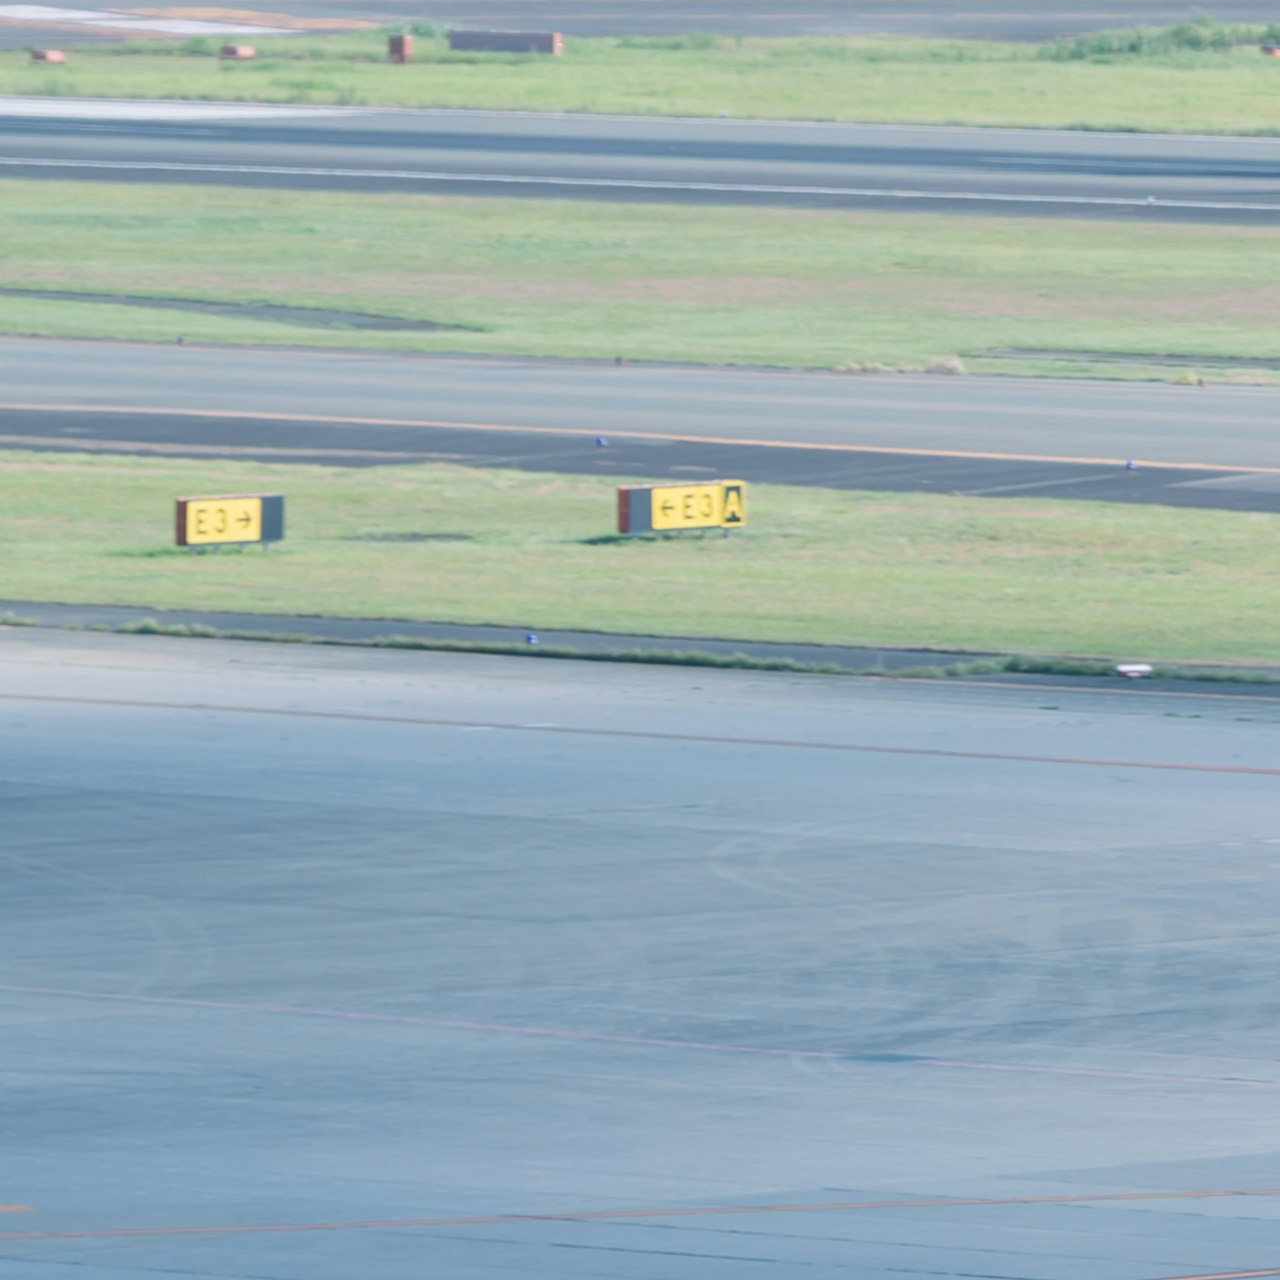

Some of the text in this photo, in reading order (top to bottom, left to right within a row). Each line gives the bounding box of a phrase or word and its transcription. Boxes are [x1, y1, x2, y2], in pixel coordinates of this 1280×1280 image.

[682, 485, 744, 521] E3 A
[195, 507, 228, 536] E3
